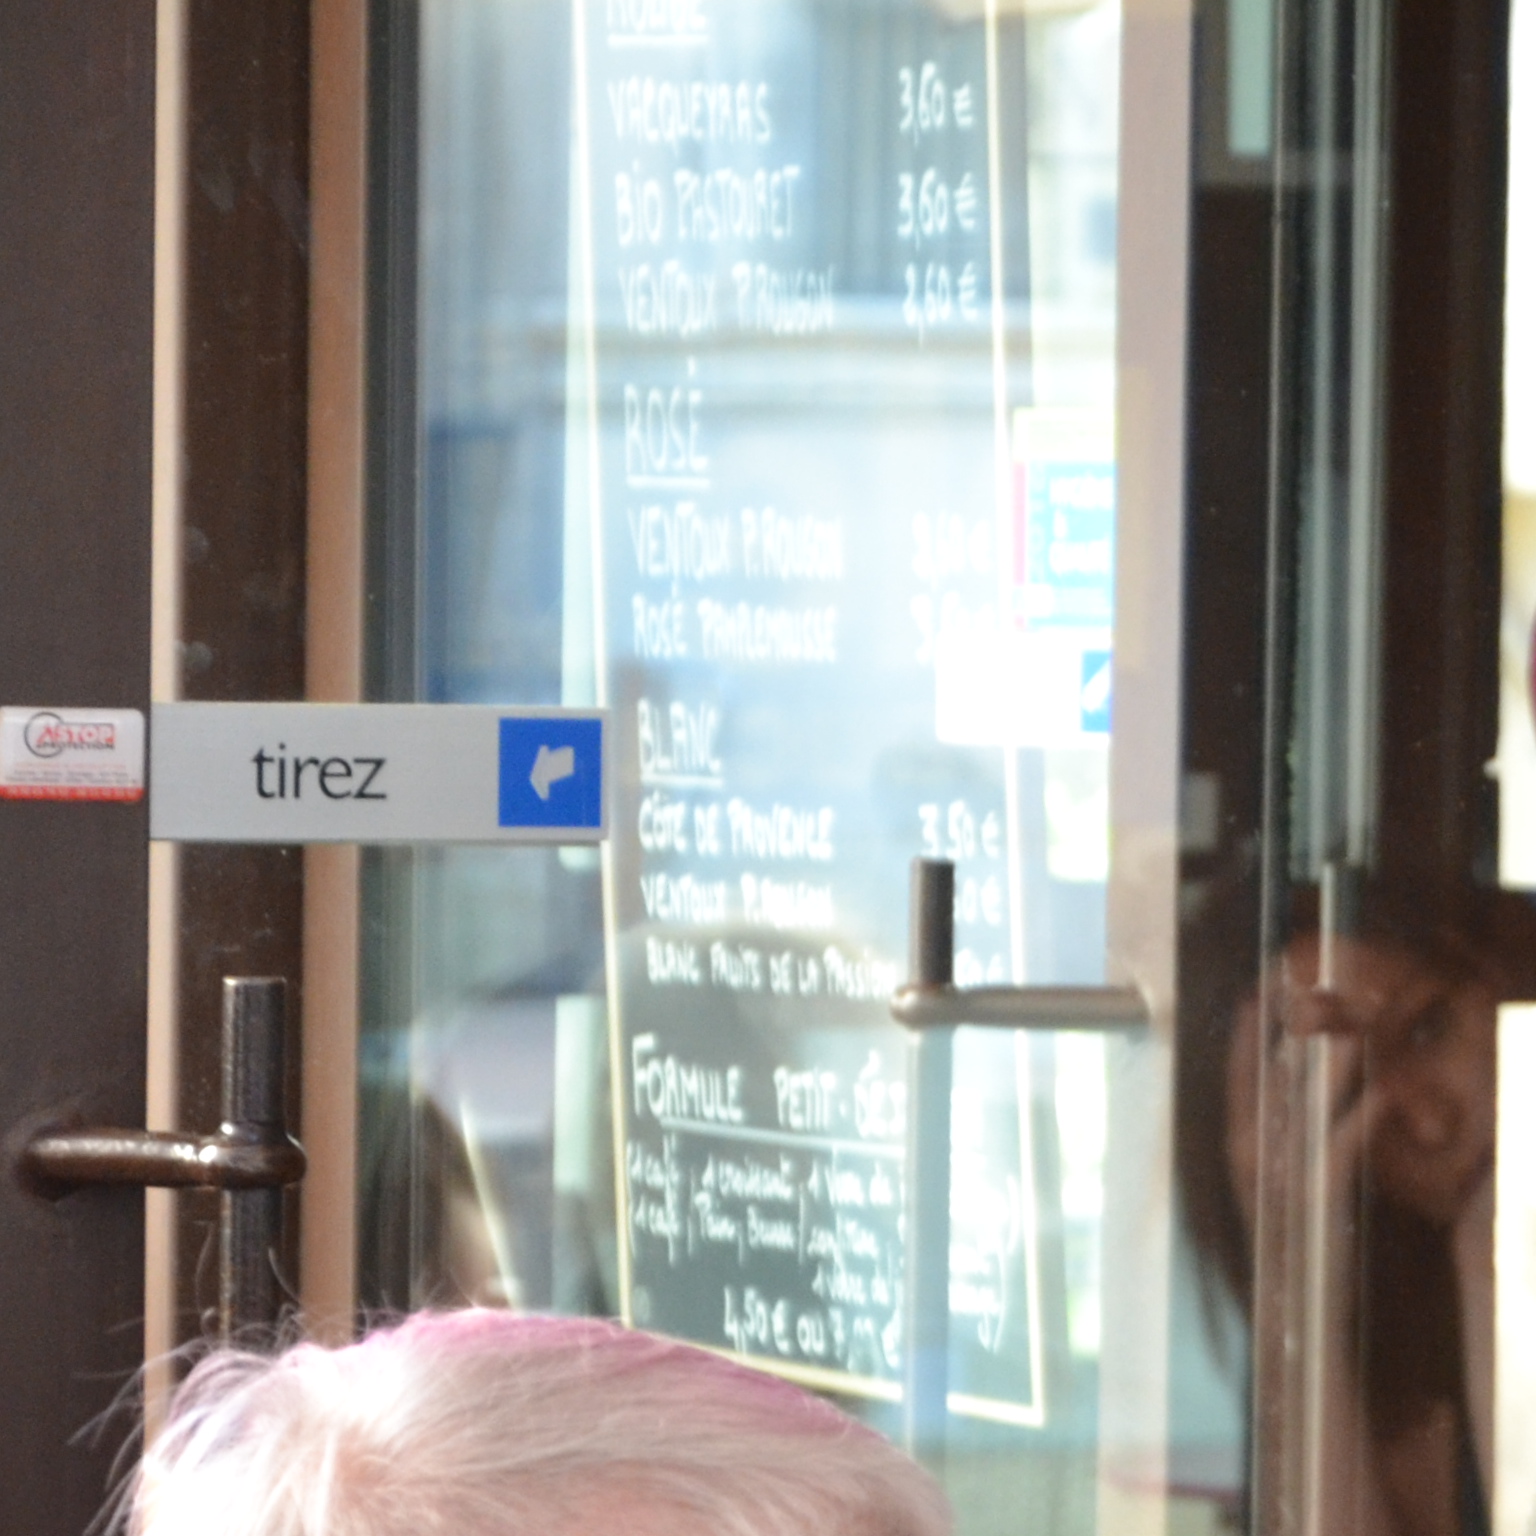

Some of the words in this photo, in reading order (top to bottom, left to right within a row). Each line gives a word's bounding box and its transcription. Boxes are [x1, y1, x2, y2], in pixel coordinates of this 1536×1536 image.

[251, 743, 387, 799] tirez
[694, 805, 719, 855] DE
[632, 1033, 743, 1122] FORMULE
